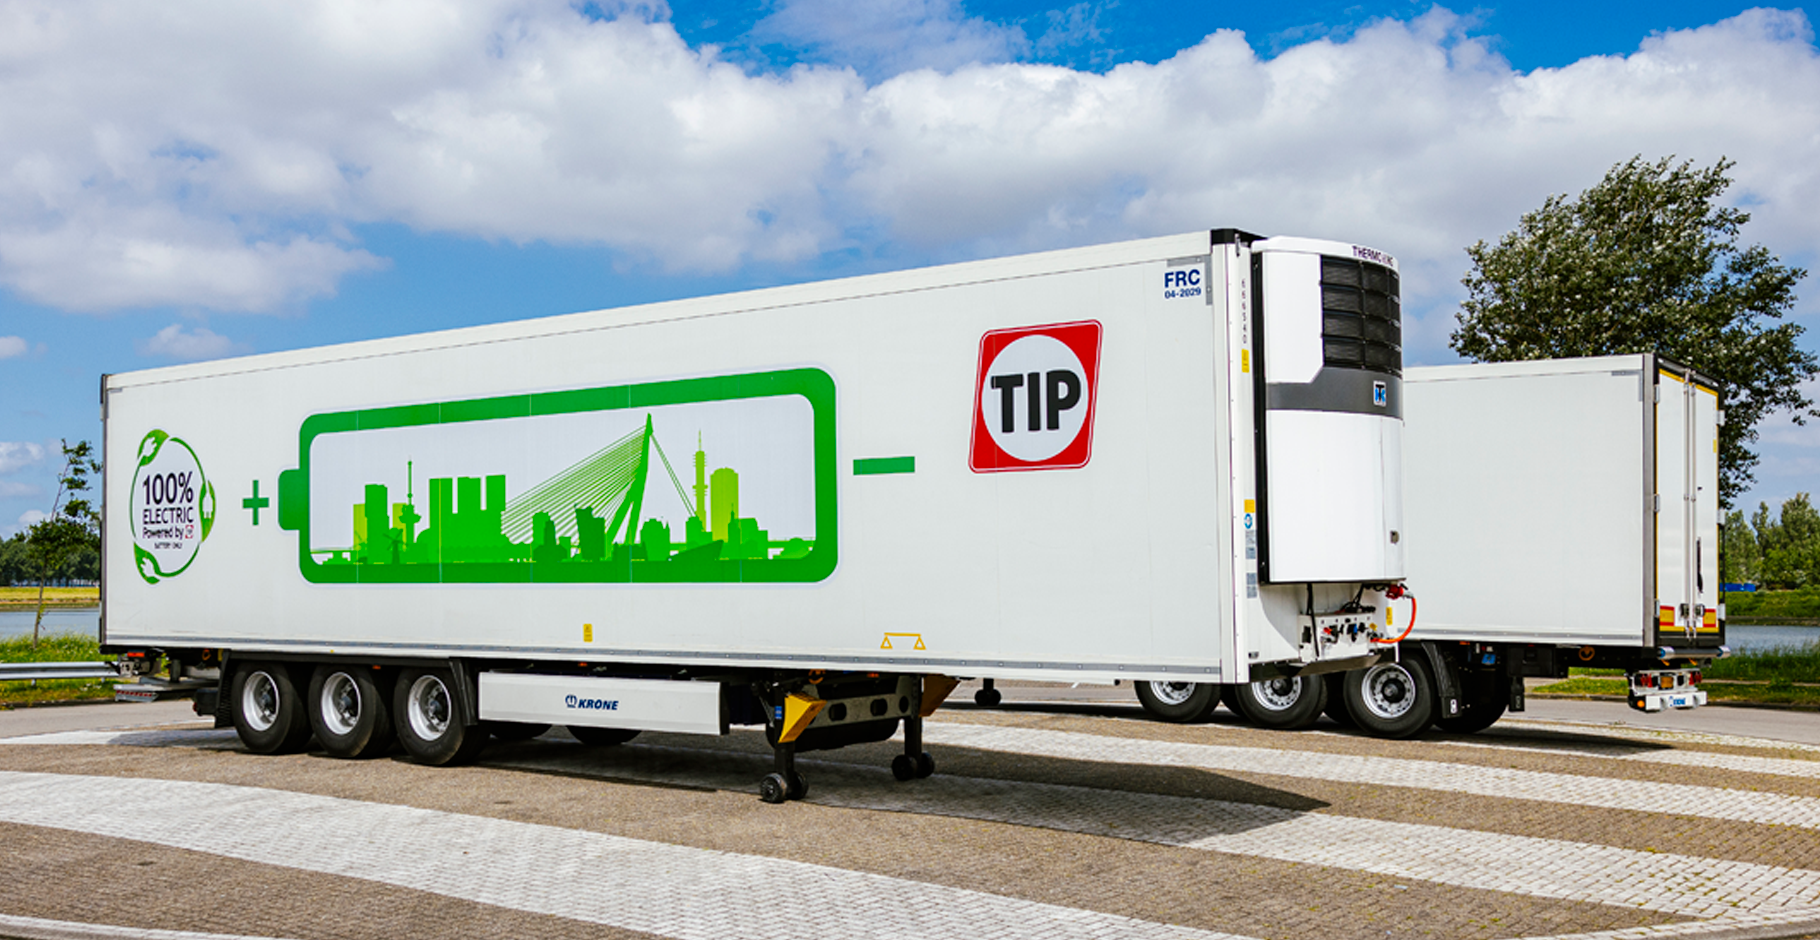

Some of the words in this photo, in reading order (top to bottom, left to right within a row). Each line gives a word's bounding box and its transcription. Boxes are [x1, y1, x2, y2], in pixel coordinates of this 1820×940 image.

[1164, 269, 1200, 288] FRC
[1164, 287, 1201, 299] 04-2029
[990, 369, 1081, 433] TIP
[142, 471, 194, 505] 100%
[143, 507, 194, 524] ELECTRIC
[143, 526, 173, 539] Powered
[175, 526, 184, 540] by
[578, 698, 619, 710] KRONE
